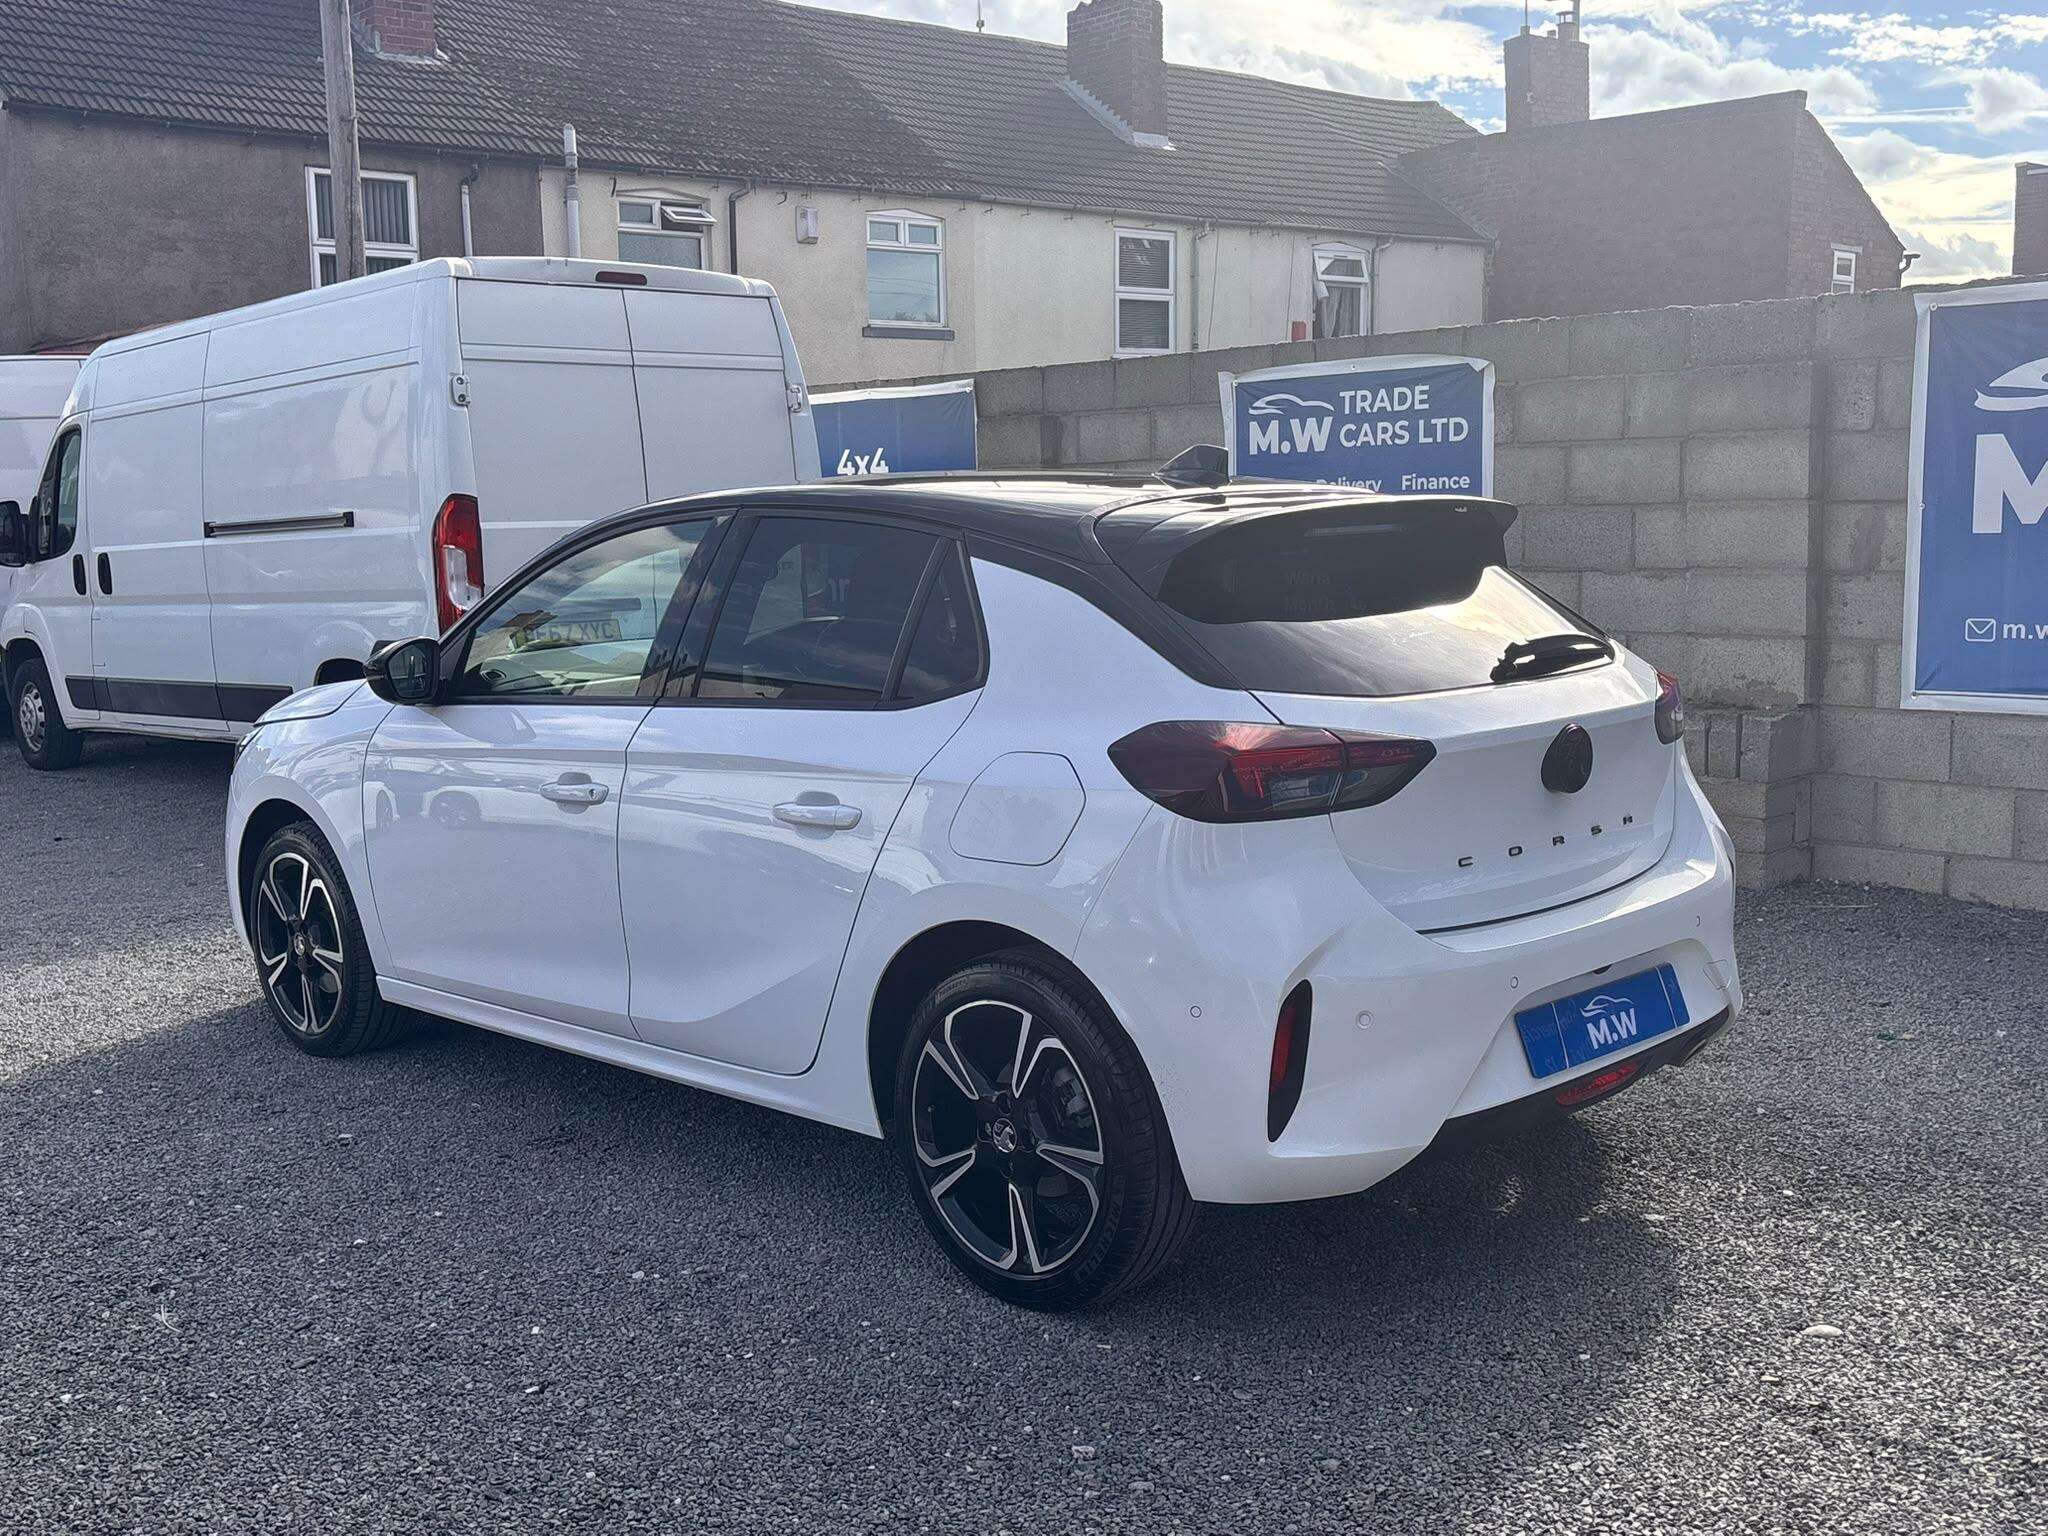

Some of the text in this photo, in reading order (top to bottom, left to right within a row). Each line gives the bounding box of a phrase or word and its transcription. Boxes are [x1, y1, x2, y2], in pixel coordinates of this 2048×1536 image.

[1339, 384, 1430, 415] TRADE
[1248, 416, 1333, 456] M.W
[1339, 417, 1469, 448] CARS LTD
[837, 447, 889, 476] 4x4
[1316, 473, 1471, 492] livery Finance
[1586, 1008, 1638, 1050] M.W
